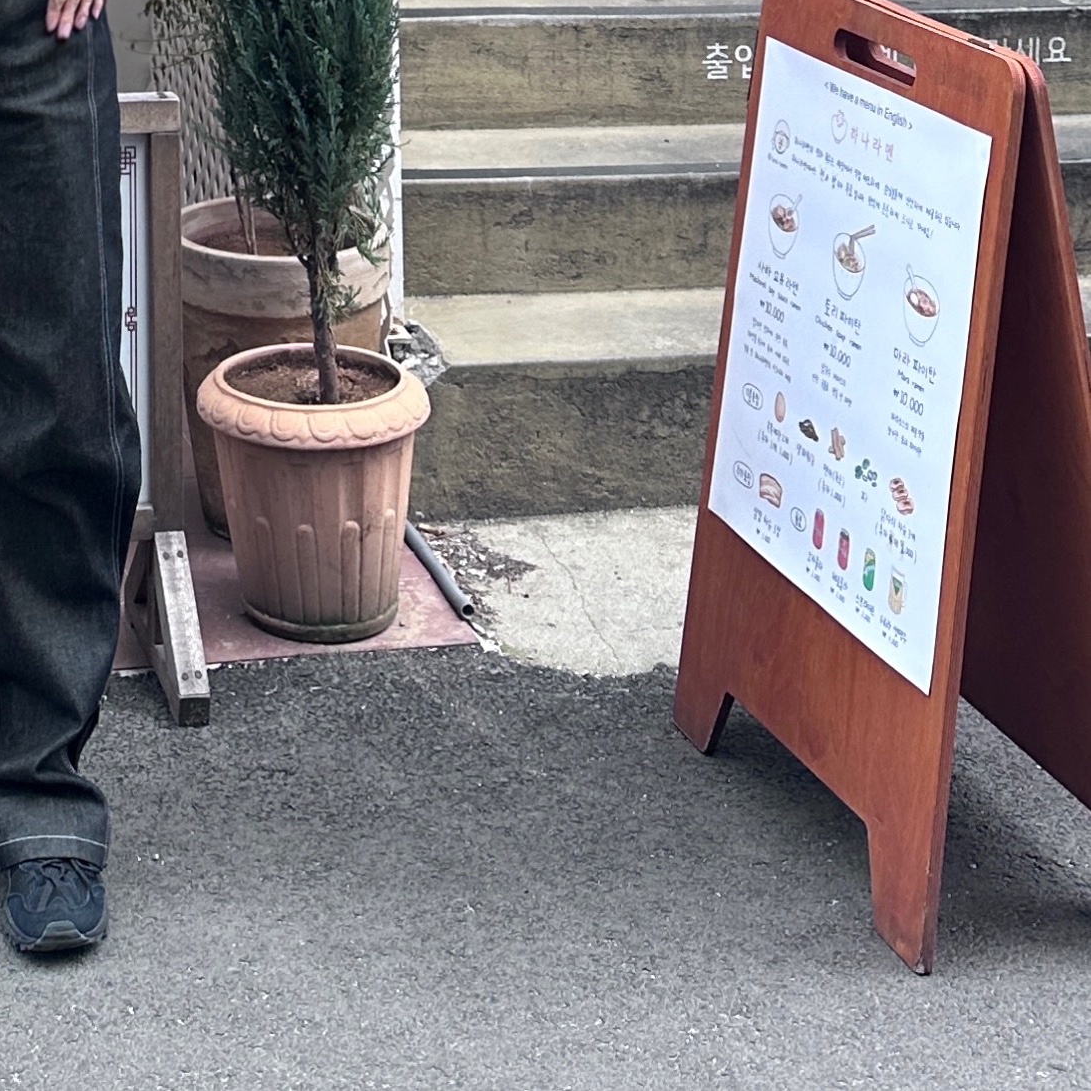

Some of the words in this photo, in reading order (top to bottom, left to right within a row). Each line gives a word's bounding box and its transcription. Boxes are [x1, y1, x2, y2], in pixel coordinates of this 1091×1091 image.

[840, 86, 854, 102] have
[859, 98, 876, 113] menu
[884, 107, 907, 127] English
[893, 347, 911, 367] 마라
[913, 358, 937, 385] 파이탄
